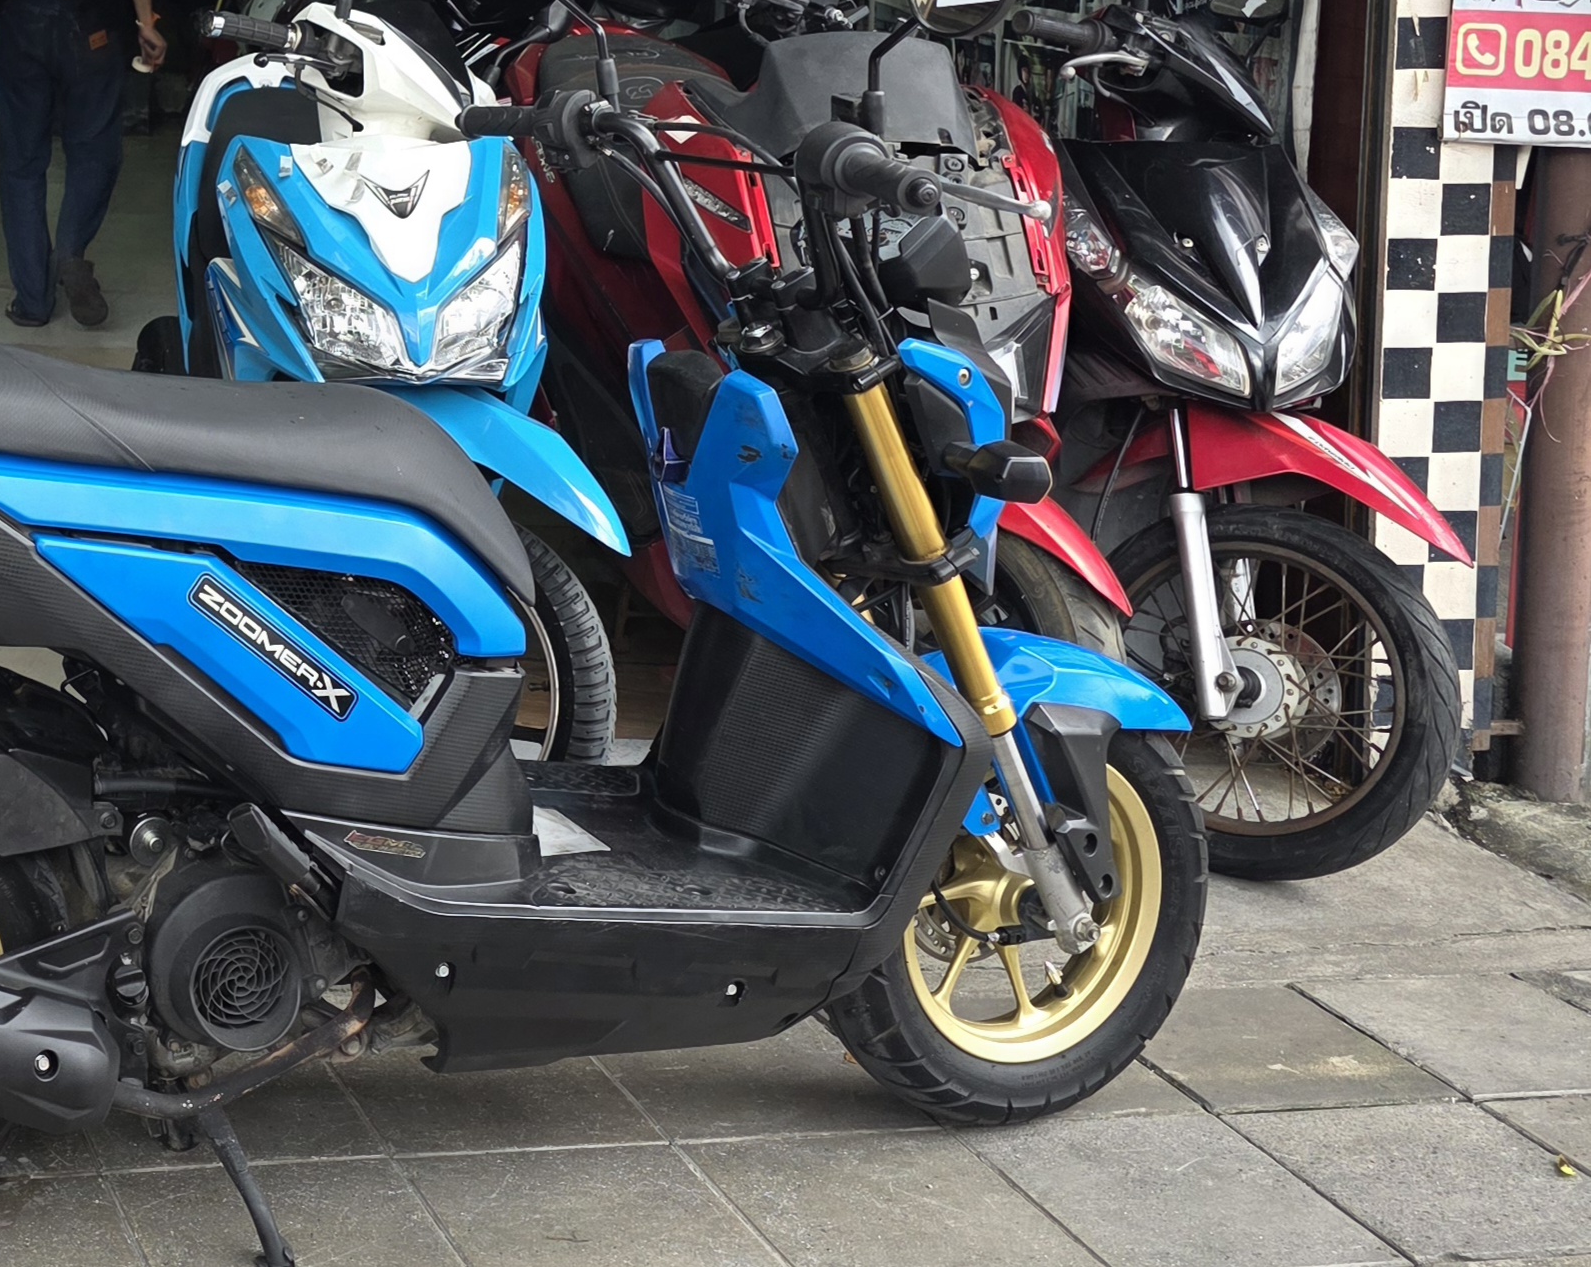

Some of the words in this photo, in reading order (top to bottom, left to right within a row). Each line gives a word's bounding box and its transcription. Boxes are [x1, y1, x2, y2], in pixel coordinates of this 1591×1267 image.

[1453, 100, 1514, 135] เปิด
[1527, 107, 1591, 138] 08.
[198, 584, 352, 714] ZOOMER-X
